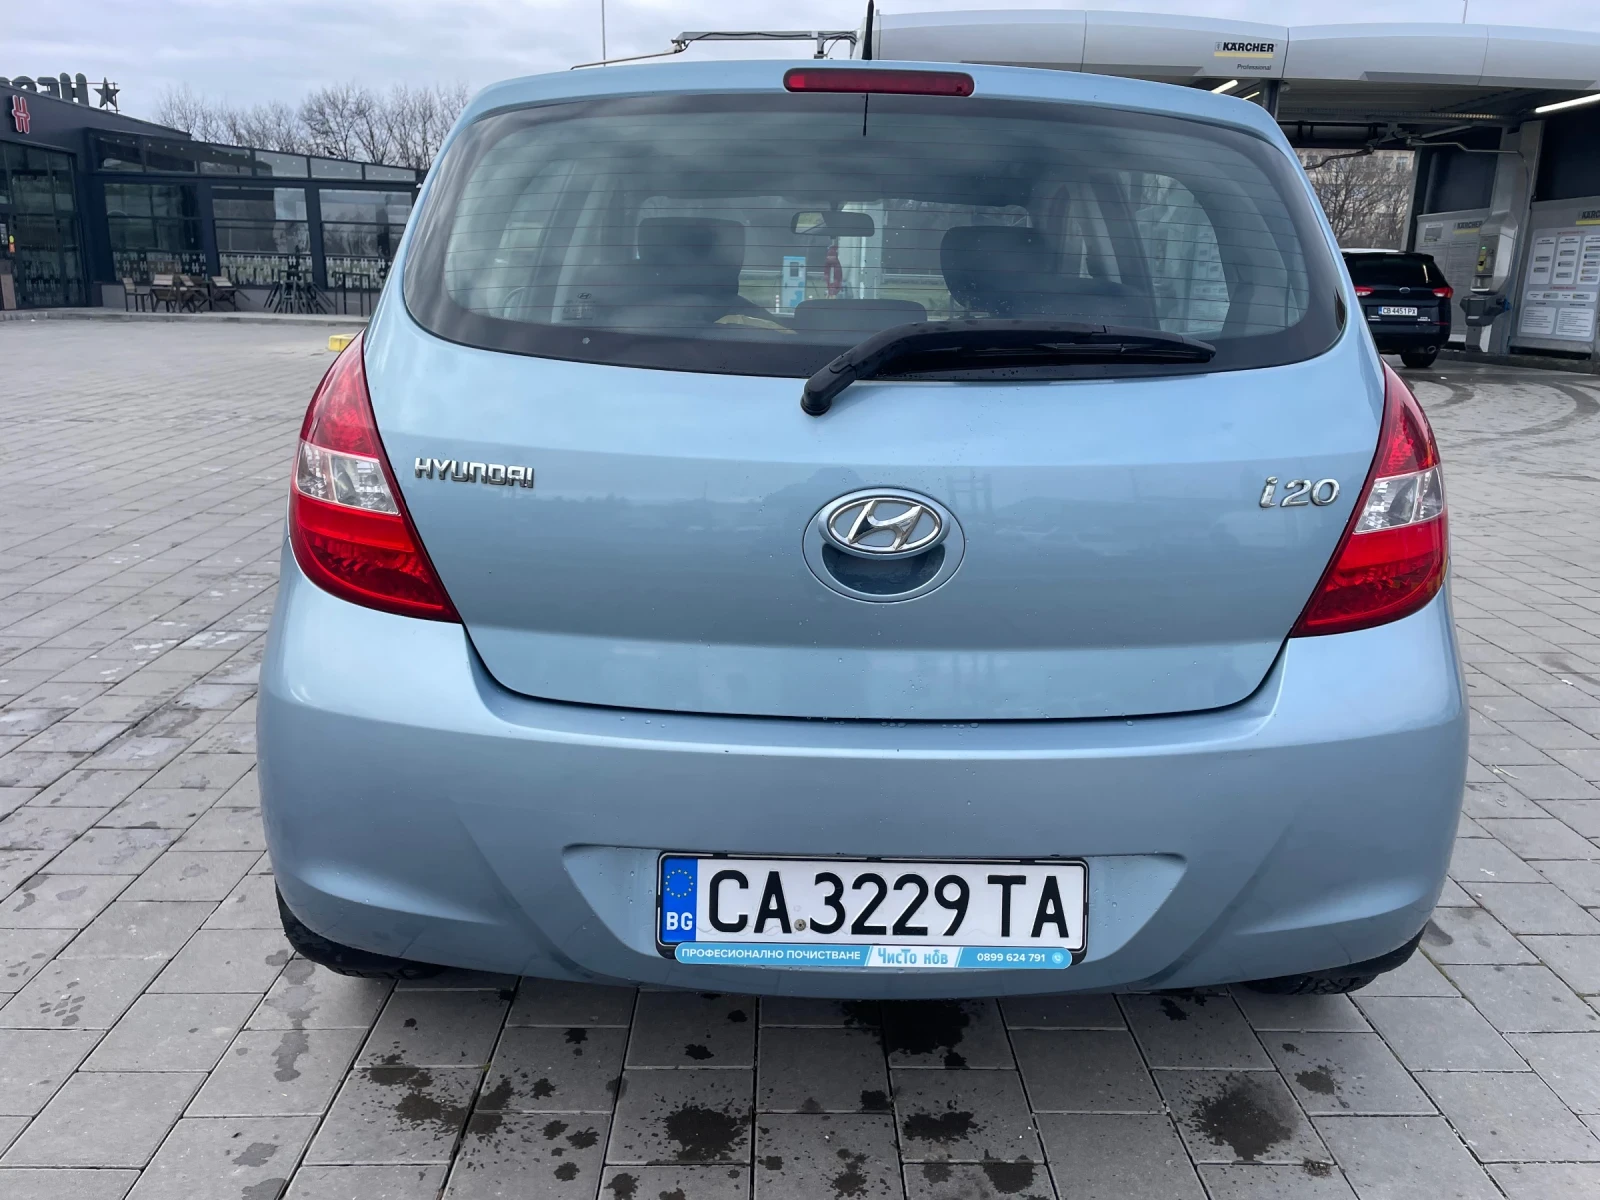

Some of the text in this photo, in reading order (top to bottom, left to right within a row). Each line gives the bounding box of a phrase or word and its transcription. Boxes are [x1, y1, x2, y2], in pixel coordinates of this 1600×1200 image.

[1222, 42, 1275, 53] KÄRCHER
[1236, 63, 1272, 71] Professional
[415, 457, 534, 488] HYUNDAI
[1259, 476, 1341, 508] i20
[708, 869, 1069, 938] CA 3229 TA
[665, 911, 693, 932] BG
[681, 948, 861, 960] ПРОФЕСИОНАЛНО ПОЧИСТВАНЕ
[976, 953, 1046, 963] 0899 624 791
